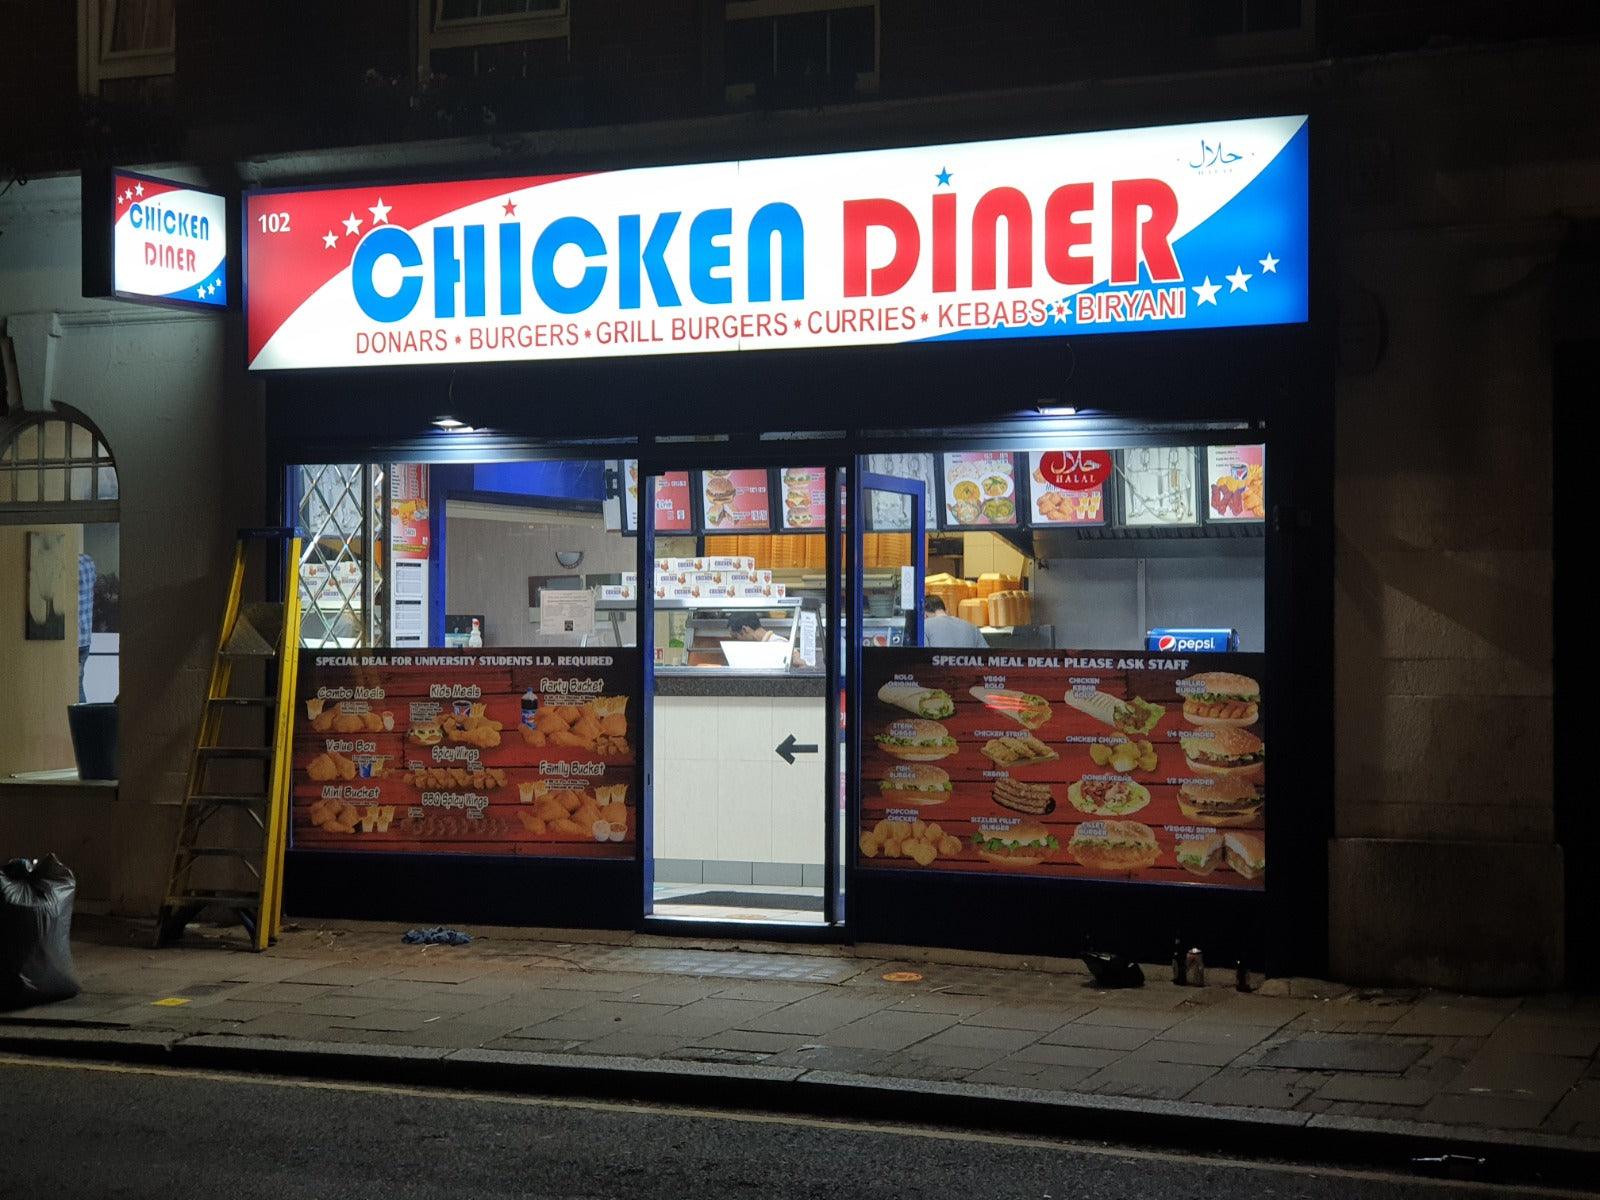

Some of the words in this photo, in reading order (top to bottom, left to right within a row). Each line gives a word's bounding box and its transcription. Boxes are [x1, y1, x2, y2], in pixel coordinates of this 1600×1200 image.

[1189, 138, 1244, 168] حلال
[129, 203, 210, 241] CHICKEN
[258, 212, 291, 234] 102
[351, 200, 804, 323] CHICKEN
[843, 176, 1182, 298] DINER
[144, 241, 197, 273] DINER
[356, 329, 448, 355] DONARS
[470, 322, 579, 351] BURGERS
[596, 319, 665, 346] GRILL
[671, 312, 788, 344] BURGERS
[807, 307, 915, 334] CURRIES
[937, 298, 1047, 329] KEBABS
[1076, 288, 1186, 322] BIRYANI
[1055, 474, 1096, 484] HALAL
[1177, 637, 1214, 651] pepsi
[315, 656, 359, 666] SPECIAL
[361, 656, 388, 666] DEAL
[391, 656, 412, 666] FOR
[415, 656, 477, 666] UNIVERSITY
[479, 656, 533, 666] STUDENTS
[536, 656, 554, 666] I.D.
[557, 656, 613, 667] REQUIRED
[931, 655, 985, 667] SPECIAL
[988, 656, 1024, 667] MEAL
[1027, 657, 1060, 668] DEAL
[1064, 657, 1114, 669] PLEASE
[1117, 658, 1145, 670] ASK
[1148, 659, 1190, 670] STAFF
[540, 677, 569, 695] Party
[569, 678, 604, 693] Bucket
[1069, 677, 1100, 685] CHICKEN
[317, 687, 353, 699] Combo
[354, 686, 385, 699] Meals
[430, 684, 451, 698] Kids
[452, 684, 482, 698] Meals
[974, 730, 1004, 738] CHICKEN
[1065, 735, 1097, 743] CHICKEN
[326, 739, 354, 753] Value
[355, 739, 376, 753] Box
[432, 745, 455, 762] Spicy
[539, 760, 570, 777] Family
[571, 761, 606, 776] Bucket
[322, 785, 343, 798] Mini
[344, 785, 380, 798] Bucket
[441, 792, 465, 809] Spicy
[886, 808, 919, 816] POPCORN
